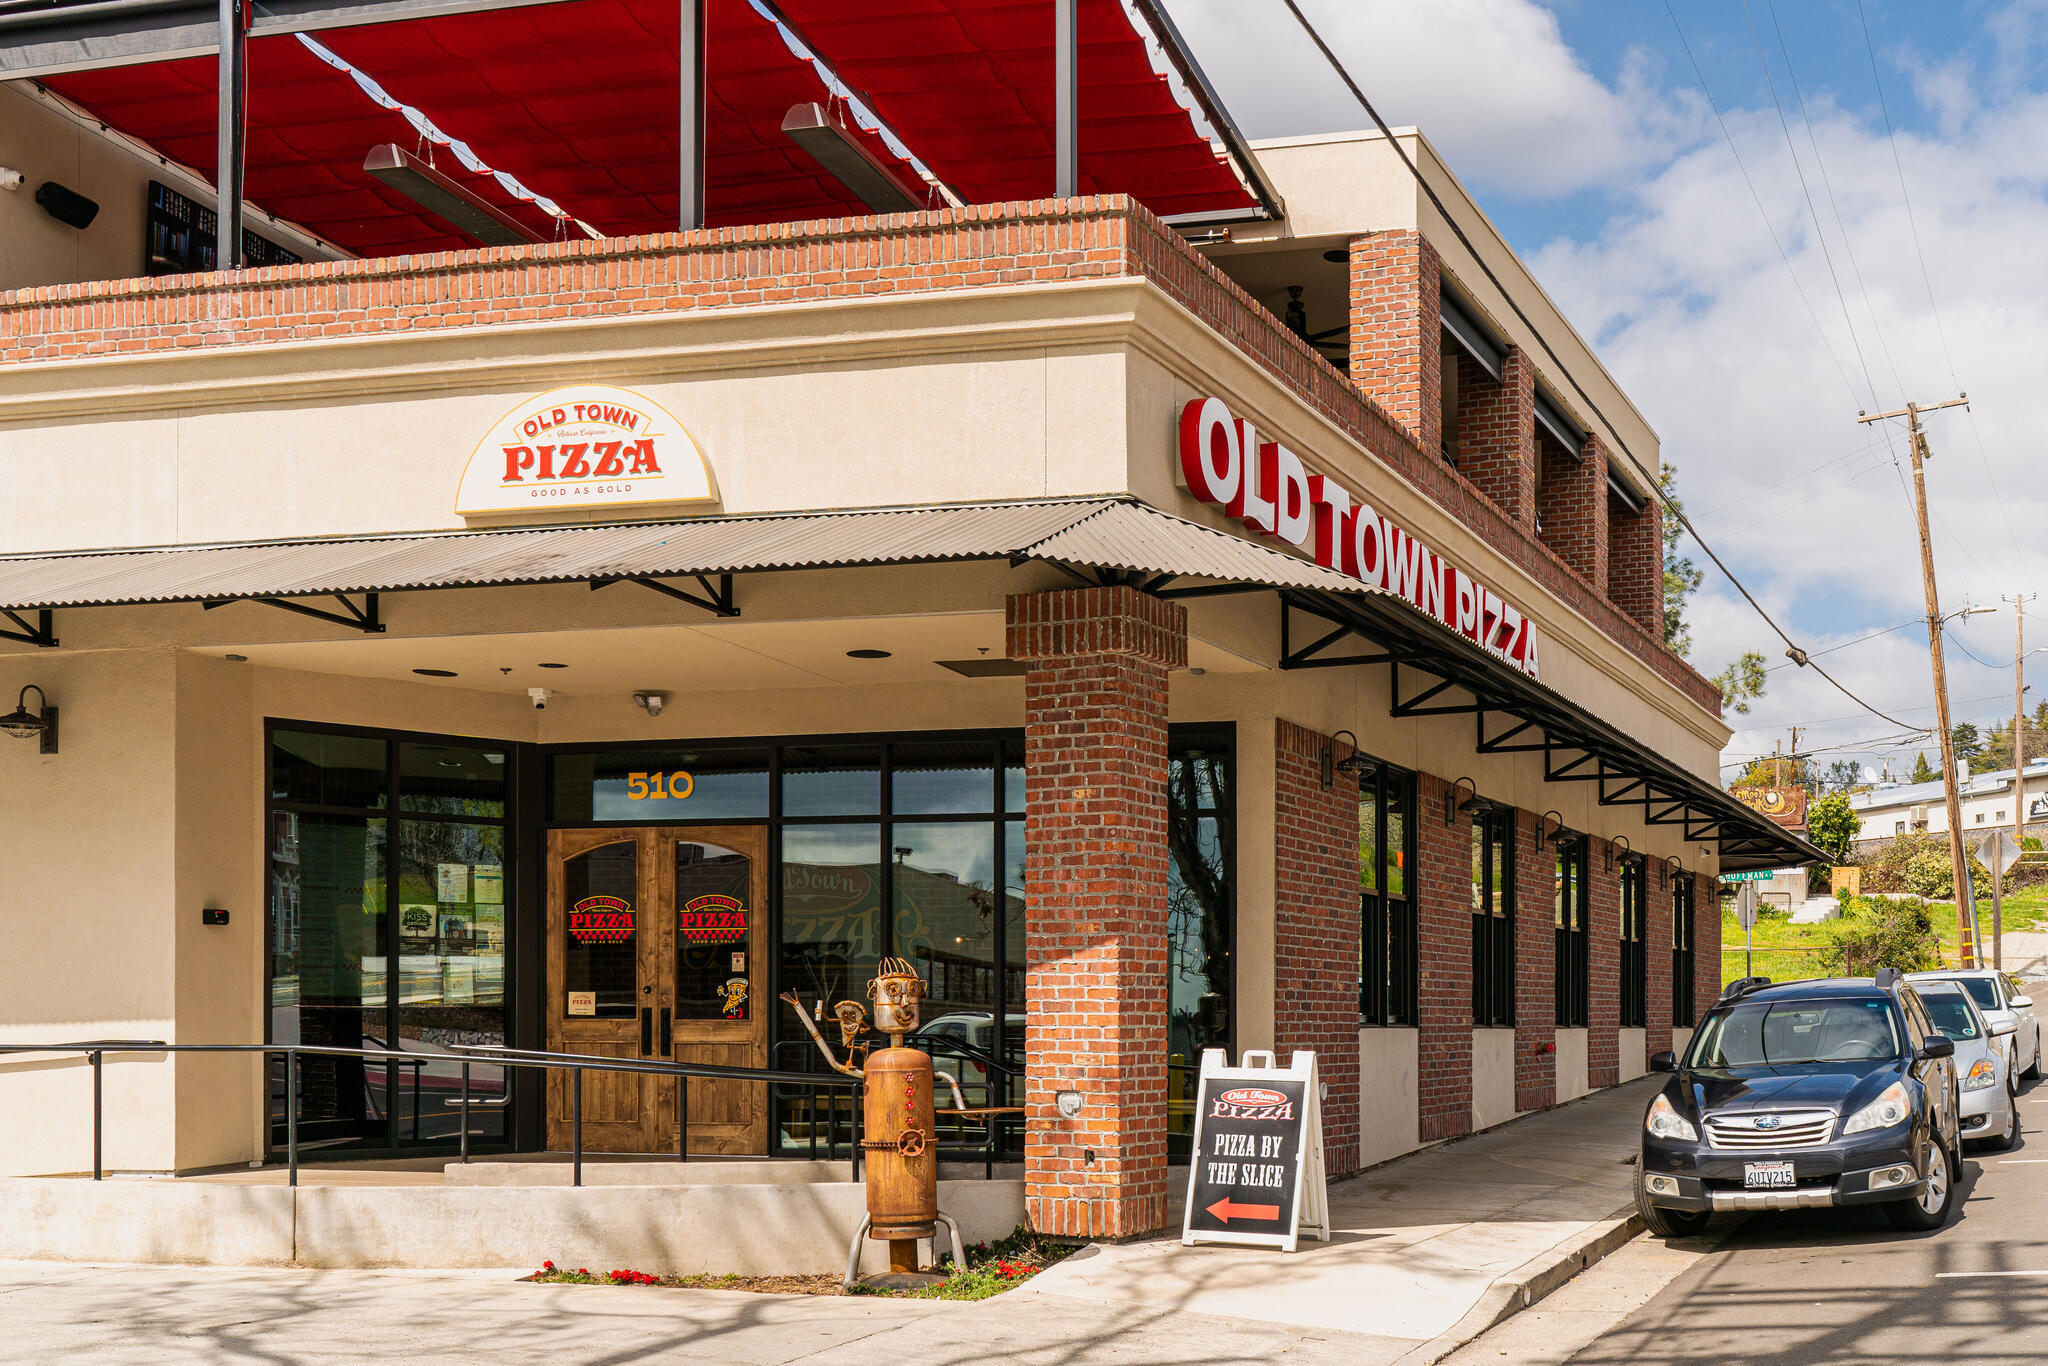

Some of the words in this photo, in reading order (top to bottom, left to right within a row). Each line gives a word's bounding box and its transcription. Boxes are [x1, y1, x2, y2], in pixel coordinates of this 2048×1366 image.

[523, 407, 566, 437] OLD
[573, 404, 638, 430] TOWN
[502, 438, 662, 482] PIZZA
[531, 488, 567, 498] GOOD
[574, 486, 590, 496] AS
[597, 484, 633, 494] GOLD
[1186, 396, 1311, 545] OLD
[1316, 474, 1445, 623] TOWN
[1452, 567, 1540, 682] PIZZA
[627, 771, 694, 800] 510
[578, 899, 597, 910] OLD
[598, 898, 625, 909] TOWN
[690, 898, 708, 910] OLD
[710, 897, 737, 908] TOWN
[407, 912, 428, 921] KISS
[570, 913, 635, 928] PIZZA
[681, 912, 748, 928] PIZZA
[1227, 1091, 1248, 1100] Old
[1249, 1090, 1279, 1101] Town
[1208, 1098, 1295, 1121] PIZZA
[1213, 1133, 1256, 1157] PIZZA
[1260, 1135, 1283, 1158] BY
[1207, 1162, 1238, 1185] THE
[1240, 1163, 1285, 1187] SLICE
[1747, 1170, 1793, 1185] 6UIV215
